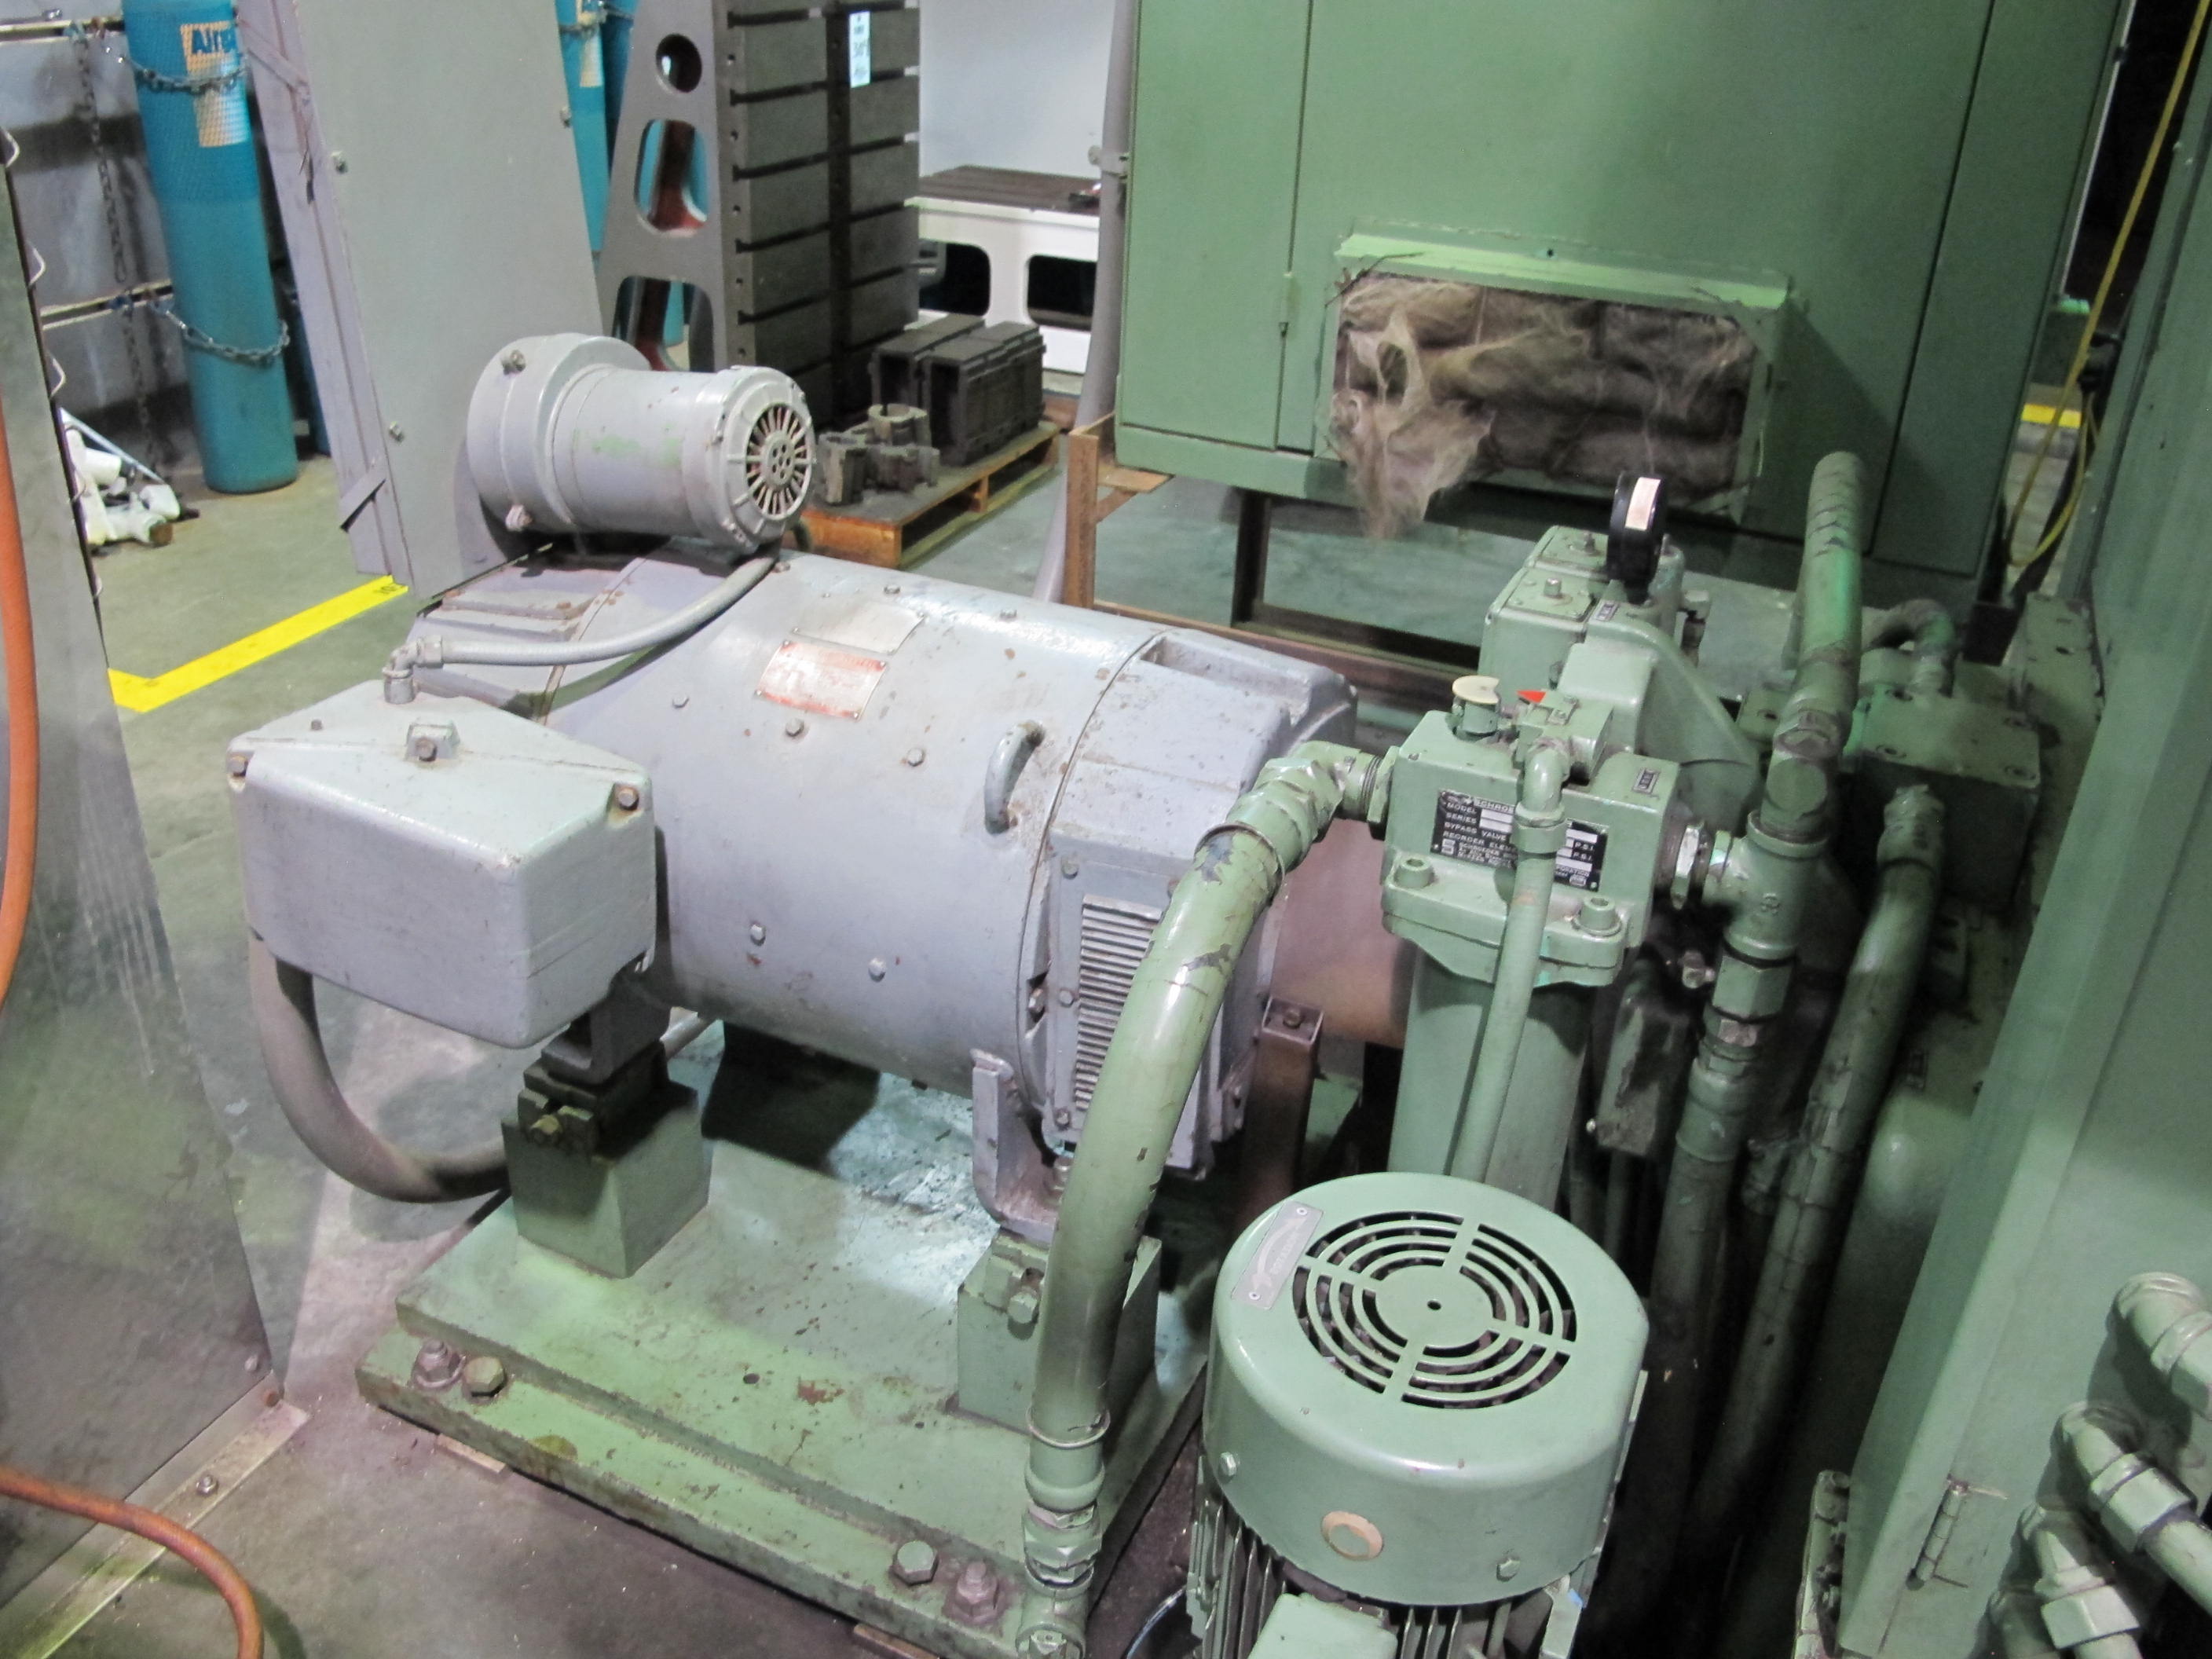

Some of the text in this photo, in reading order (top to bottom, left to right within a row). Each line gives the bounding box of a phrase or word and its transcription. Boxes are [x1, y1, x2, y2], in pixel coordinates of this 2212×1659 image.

[1447, 802, 1477, 813] MODEL
[1445, 811, 1477, 824] SERIES
[1445, 822, 1507, 841] BYPASS VALVE
